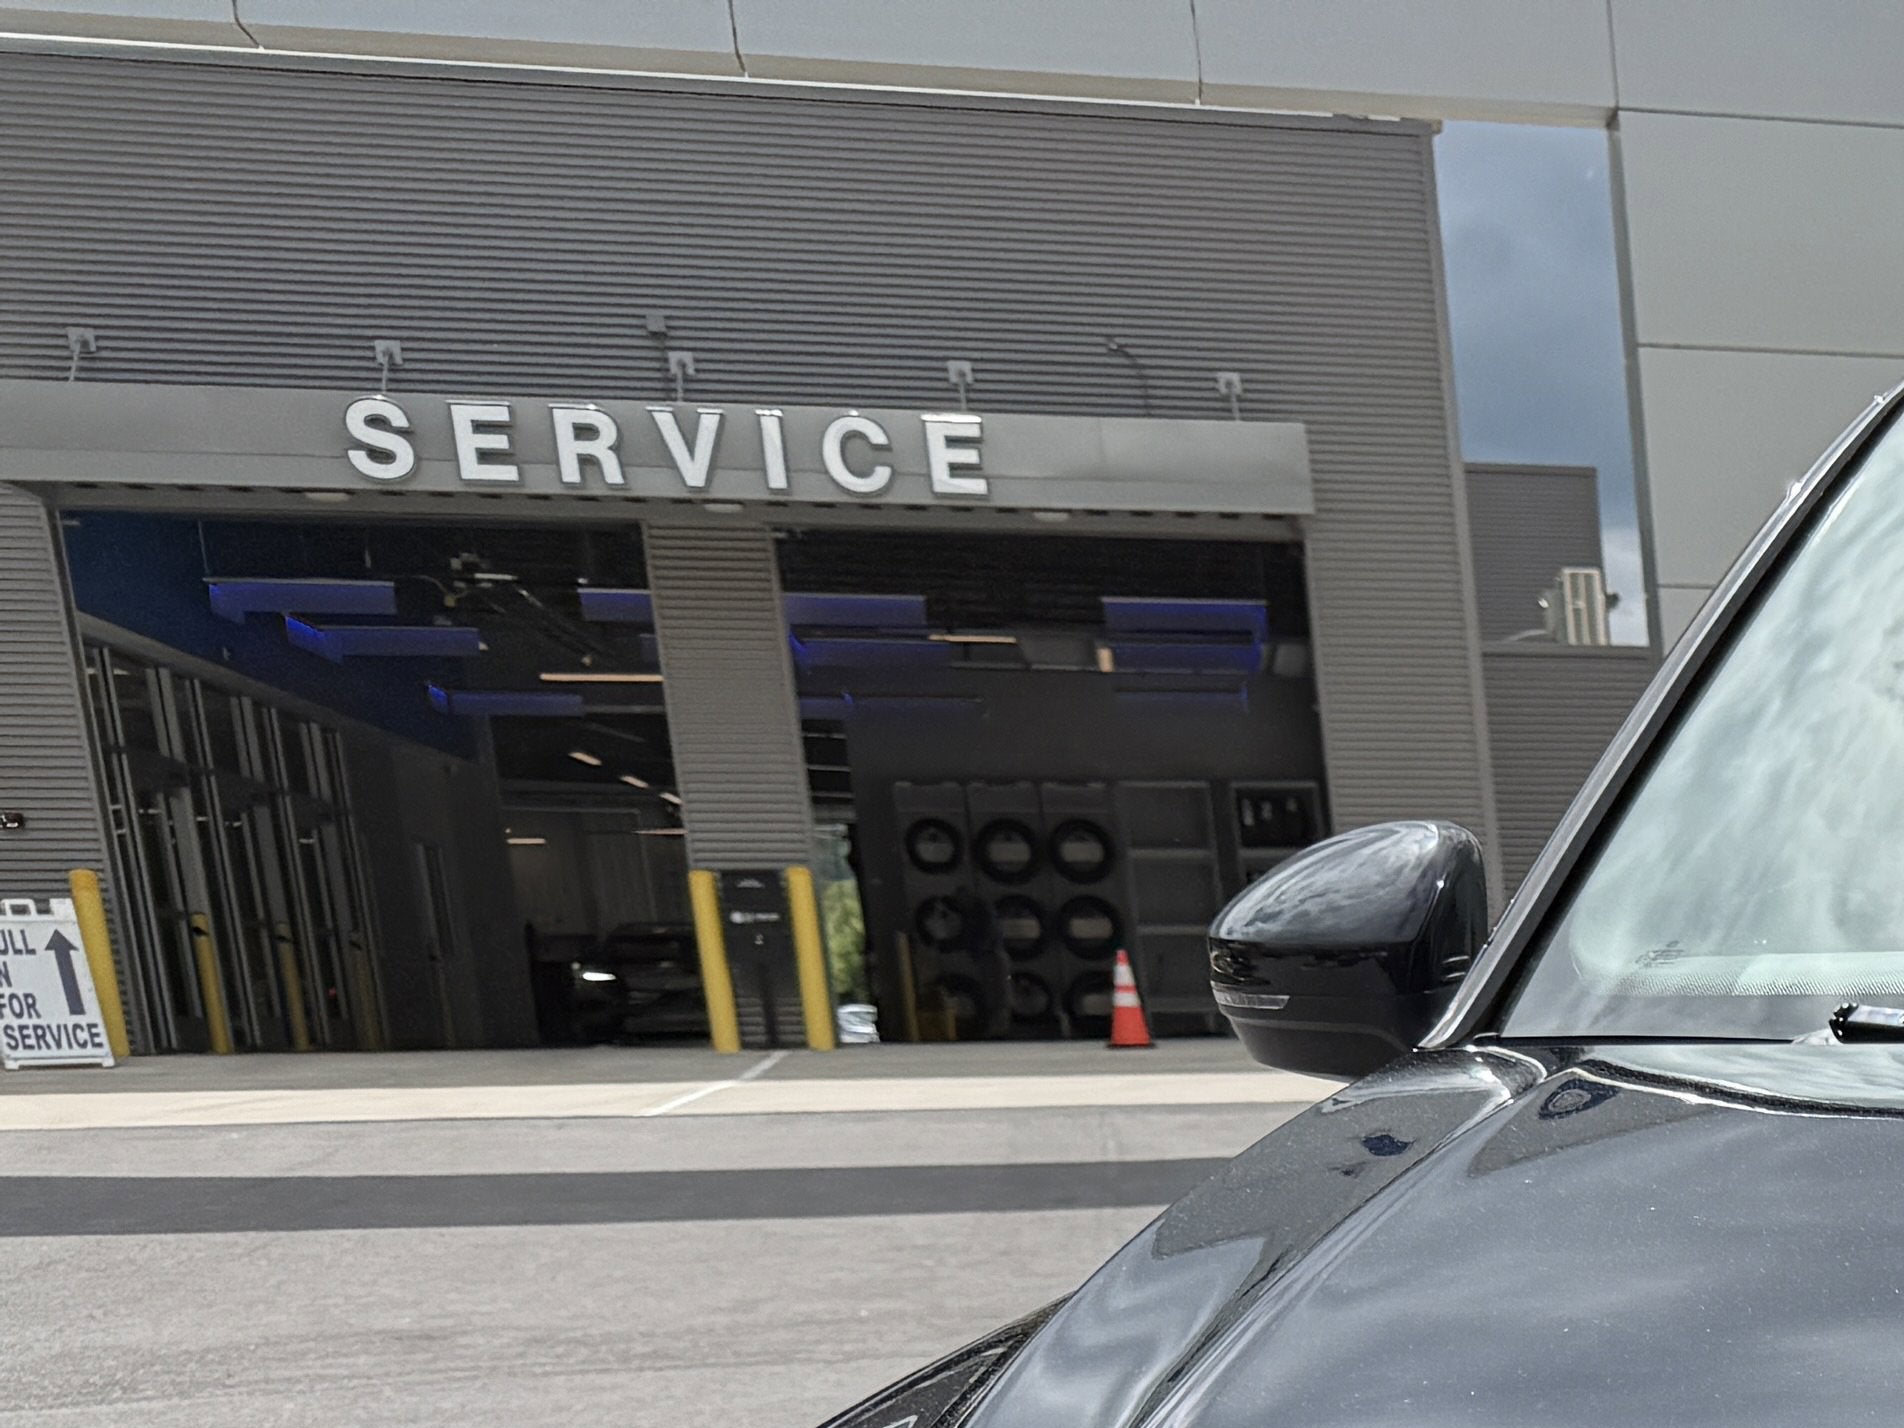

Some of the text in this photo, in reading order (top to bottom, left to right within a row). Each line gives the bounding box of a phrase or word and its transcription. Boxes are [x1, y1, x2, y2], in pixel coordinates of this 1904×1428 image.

[344, 395, 989, 496] SERVICE
[0, 928, 37, 956] ULL
[0, 960, 13, 988] N
[3, 1022, 105, 1051] SERVICE
